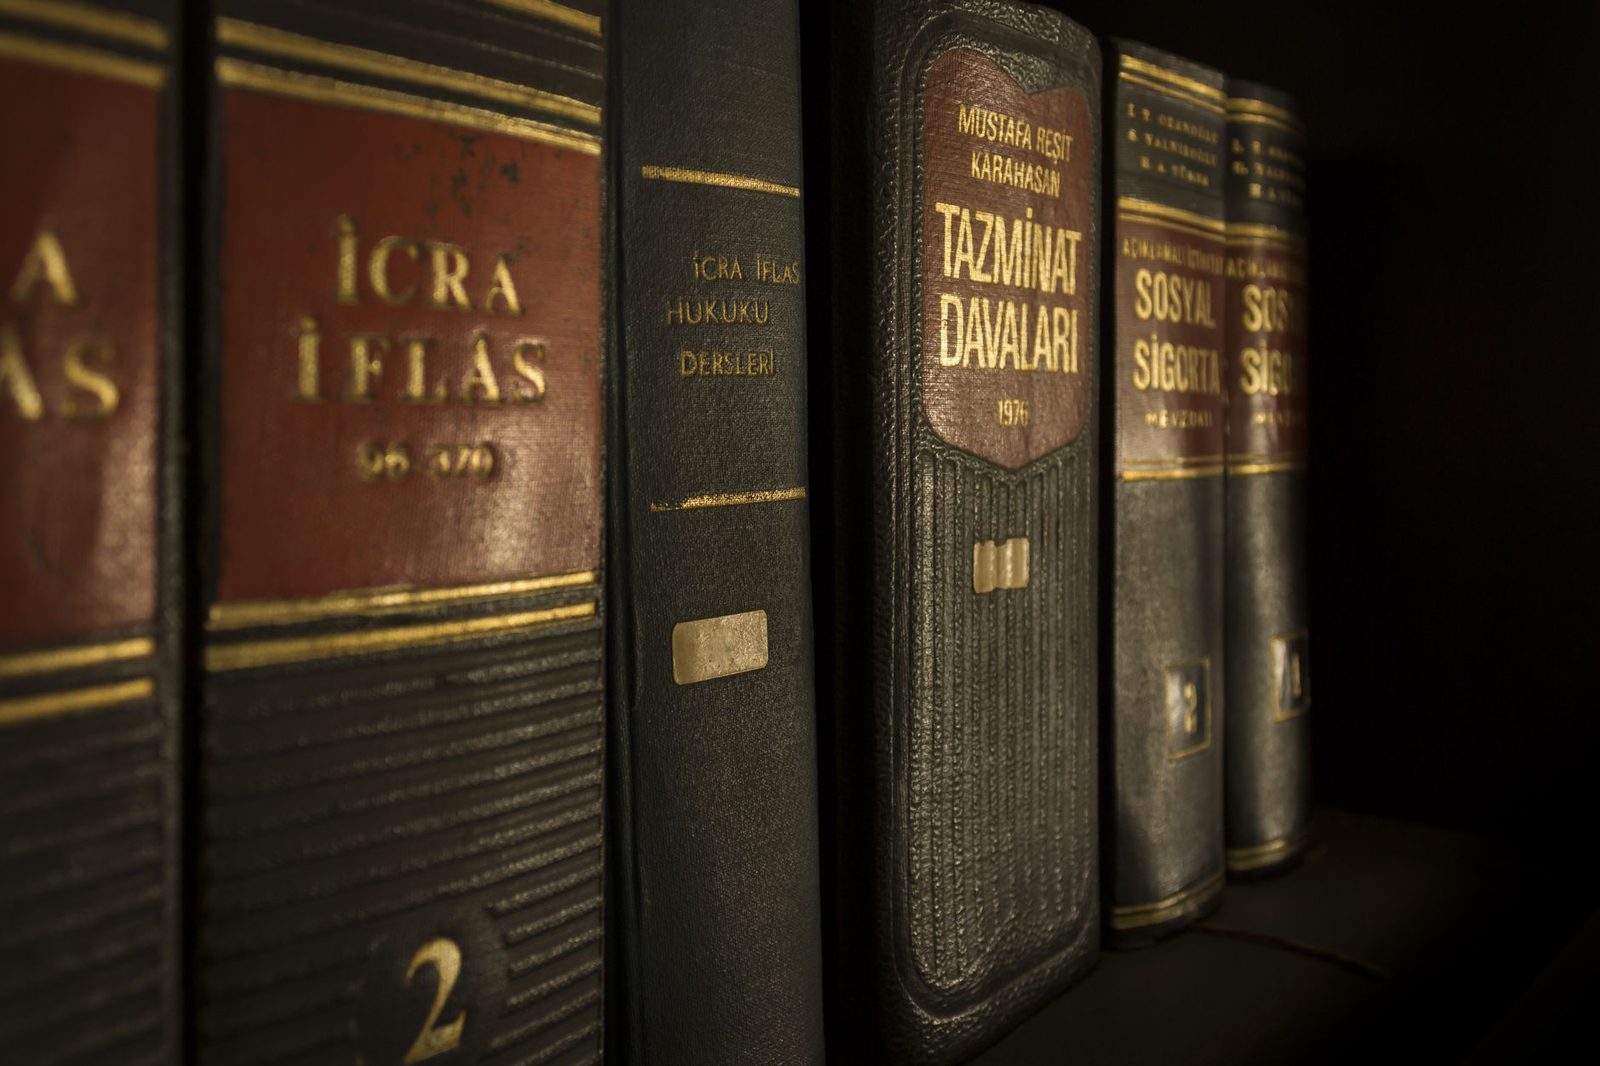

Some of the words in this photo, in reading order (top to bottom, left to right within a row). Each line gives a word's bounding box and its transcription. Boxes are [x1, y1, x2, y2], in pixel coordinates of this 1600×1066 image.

[958, 104, 1033, 152] MUSTAFA
[970, 151, 1060, 198] KARAHASAN
[8, 228, 80, 306] A
[333, 213, 524, 317] İCRA
[692, 249, 743, 282] İCRA
[935, 201, 1082, 296] TAZMİNAT
[666, 298, 769, 325] HUKUKU
[1135, 268, 1217, 330] SOSYAL
[1242, 284, 1289, 334] SOS
[290, 313, 549, 406] İFLAS
[939, 293, 1078, 374] DAVALARI
[1133, 331, 1221, 395] SİGORTA
[997, 399, 1028, 427] 1976
[391, 936, 467, 1065] 2
